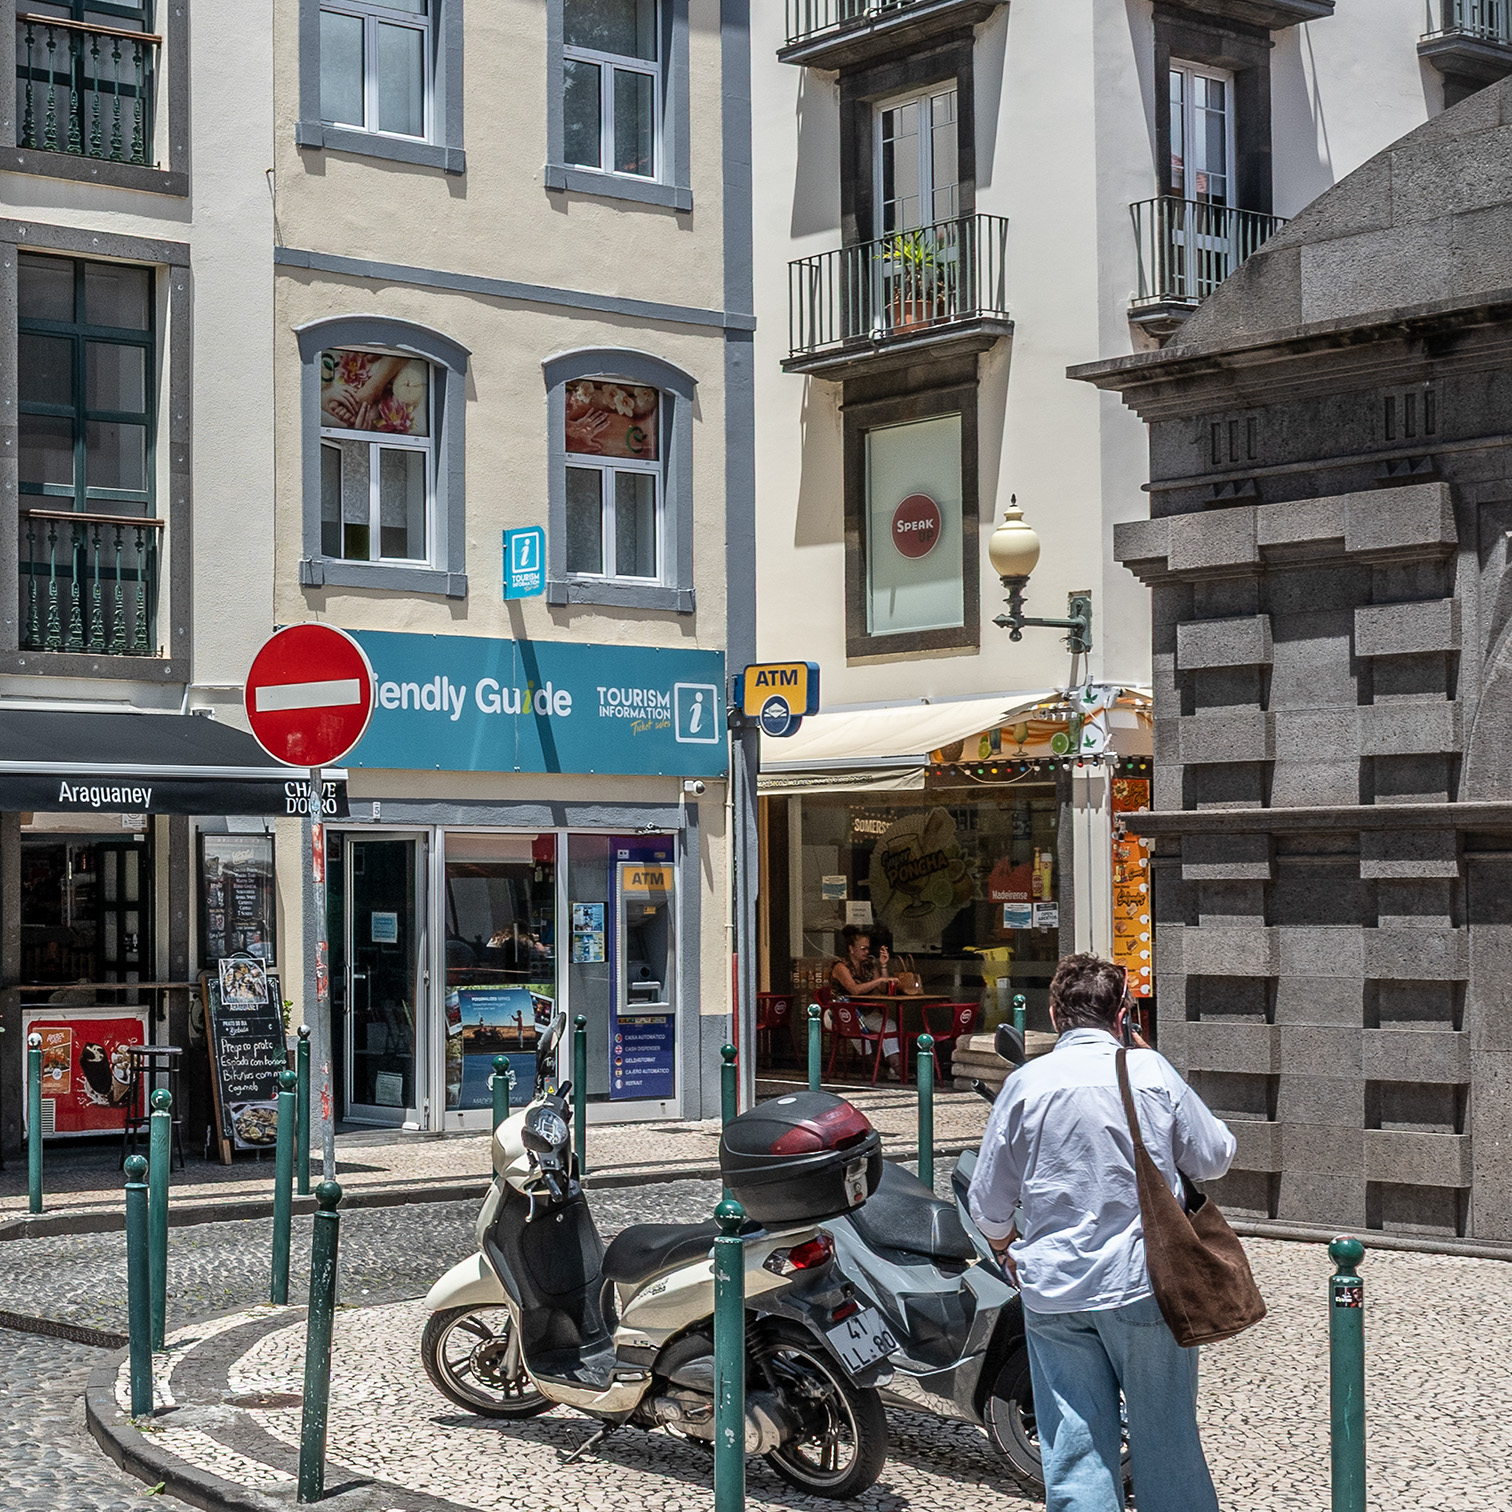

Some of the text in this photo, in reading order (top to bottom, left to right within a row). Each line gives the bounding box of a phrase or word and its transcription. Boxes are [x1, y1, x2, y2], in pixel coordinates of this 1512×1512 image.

[918, 529, 934, 542] UP
[512, 573, 540, 583] TOURISM
[512, 580, 540, 588] INFORMATION
[755, 669, 798, 687] ATM
[372, 675, 573, 721] iendly Guide
[596, 686, 671, 708] TOURISM
[599, 705, 671, 719] INFORMATION
[630, 719, 671, 736] Ticket sales
[58, 781, 152, 809] Araguaney
[284, 781, 337, 798] CHVE
[887, 850, 949, 888] PONCHA
[631, 871, 665, 885] ATM
[992, 890, 1028, 900] Madeirense
[847, 1316, 868, 1339] 41
